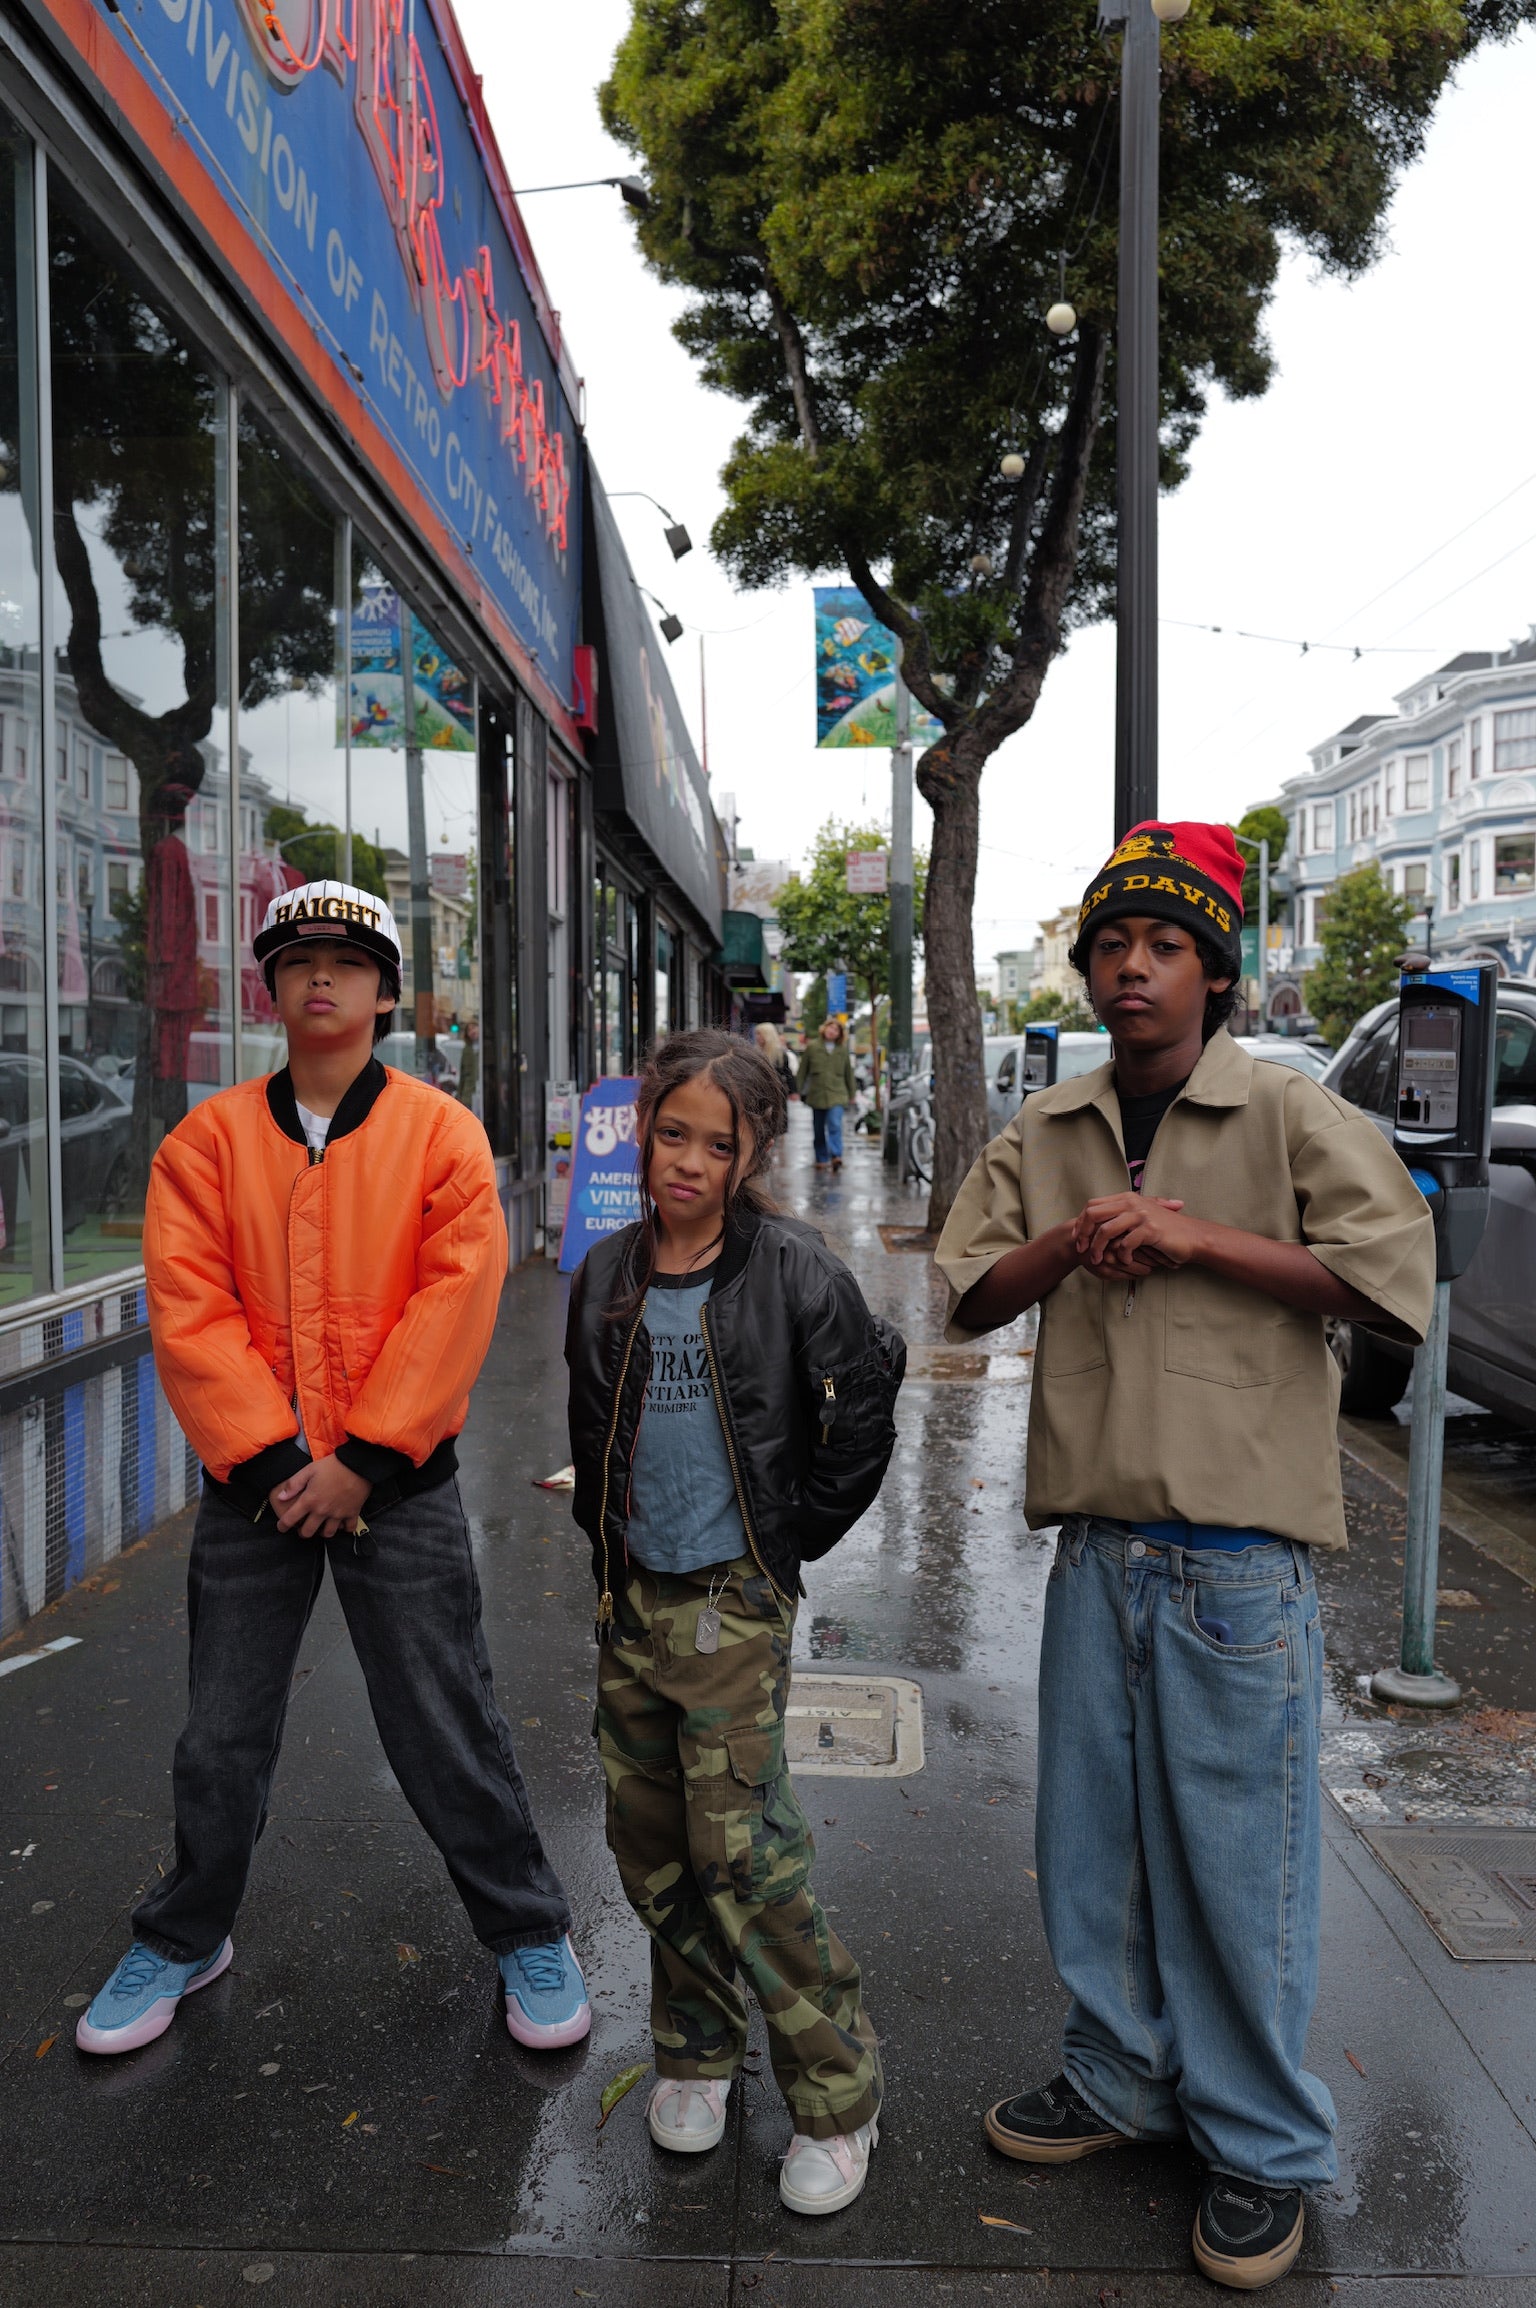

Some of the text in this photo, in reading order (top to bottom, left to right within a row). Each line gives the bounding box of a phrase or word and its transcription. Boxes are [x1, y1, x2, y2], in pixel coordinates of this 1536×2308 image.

[326, 228, 364, 313] OF
[370, 288, 441, 458] RETRO
[446, 432, 483, 538] CITY
[275, 897, 381, 929] HAIGHT
[1123, 874, 1231, 934] DAVIS
[589, 1171, 642, 1186] AMERI
[590, 1189, 645, 1206] VINTA
[650, 1333, 704, 1346] RTY OF
[649, 1348, 711, 1382] TRAZ
[645, 1383, 713, 1401] NTIARY
[649, 1402, 697, 1414] NUMBER
